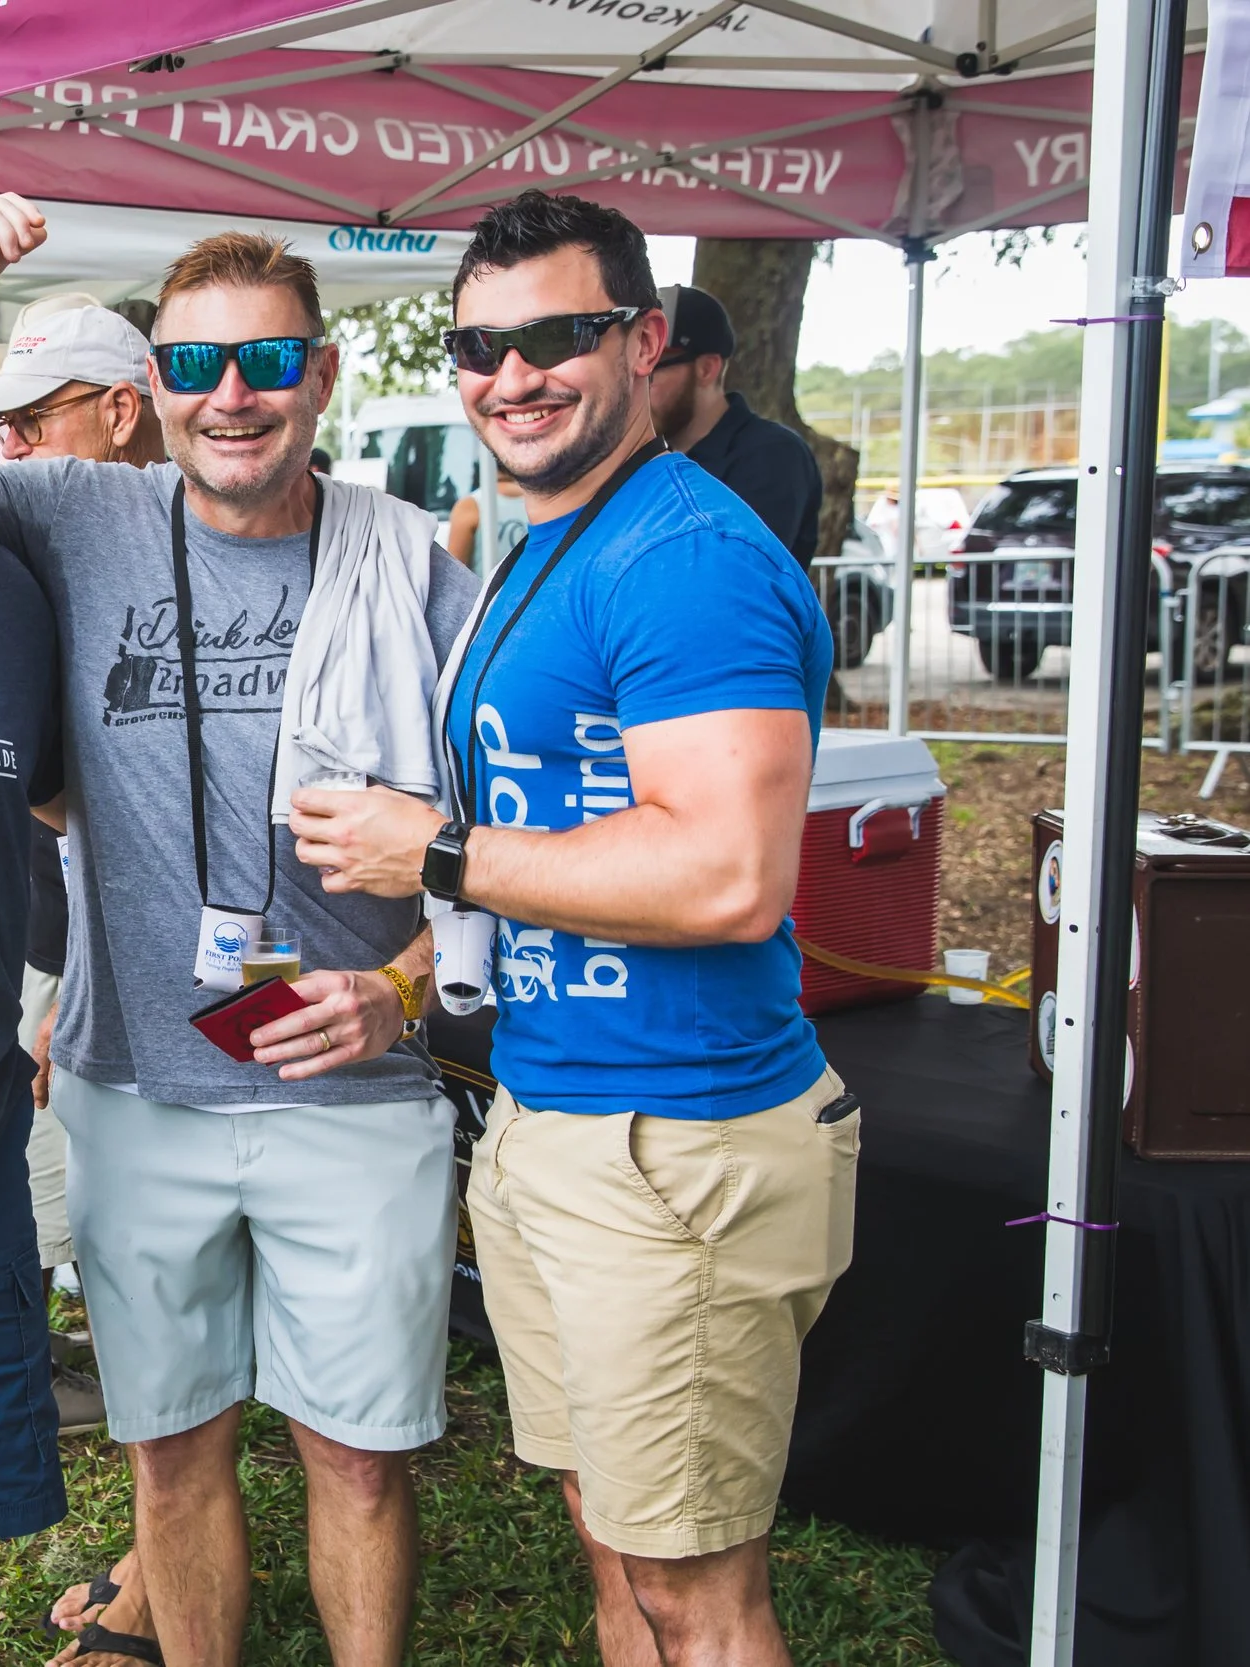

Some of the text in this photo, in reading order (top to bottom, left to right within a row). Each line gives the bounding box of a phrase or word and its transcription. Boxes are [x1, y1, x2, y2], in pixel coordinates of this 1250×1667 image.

[328, 225, 438, 253] Ohuhu
[137, 596, 250, 650] Dink
[115, 711, 187, 727] Grove City
[205, 949, 242, 962] FIRST PO
